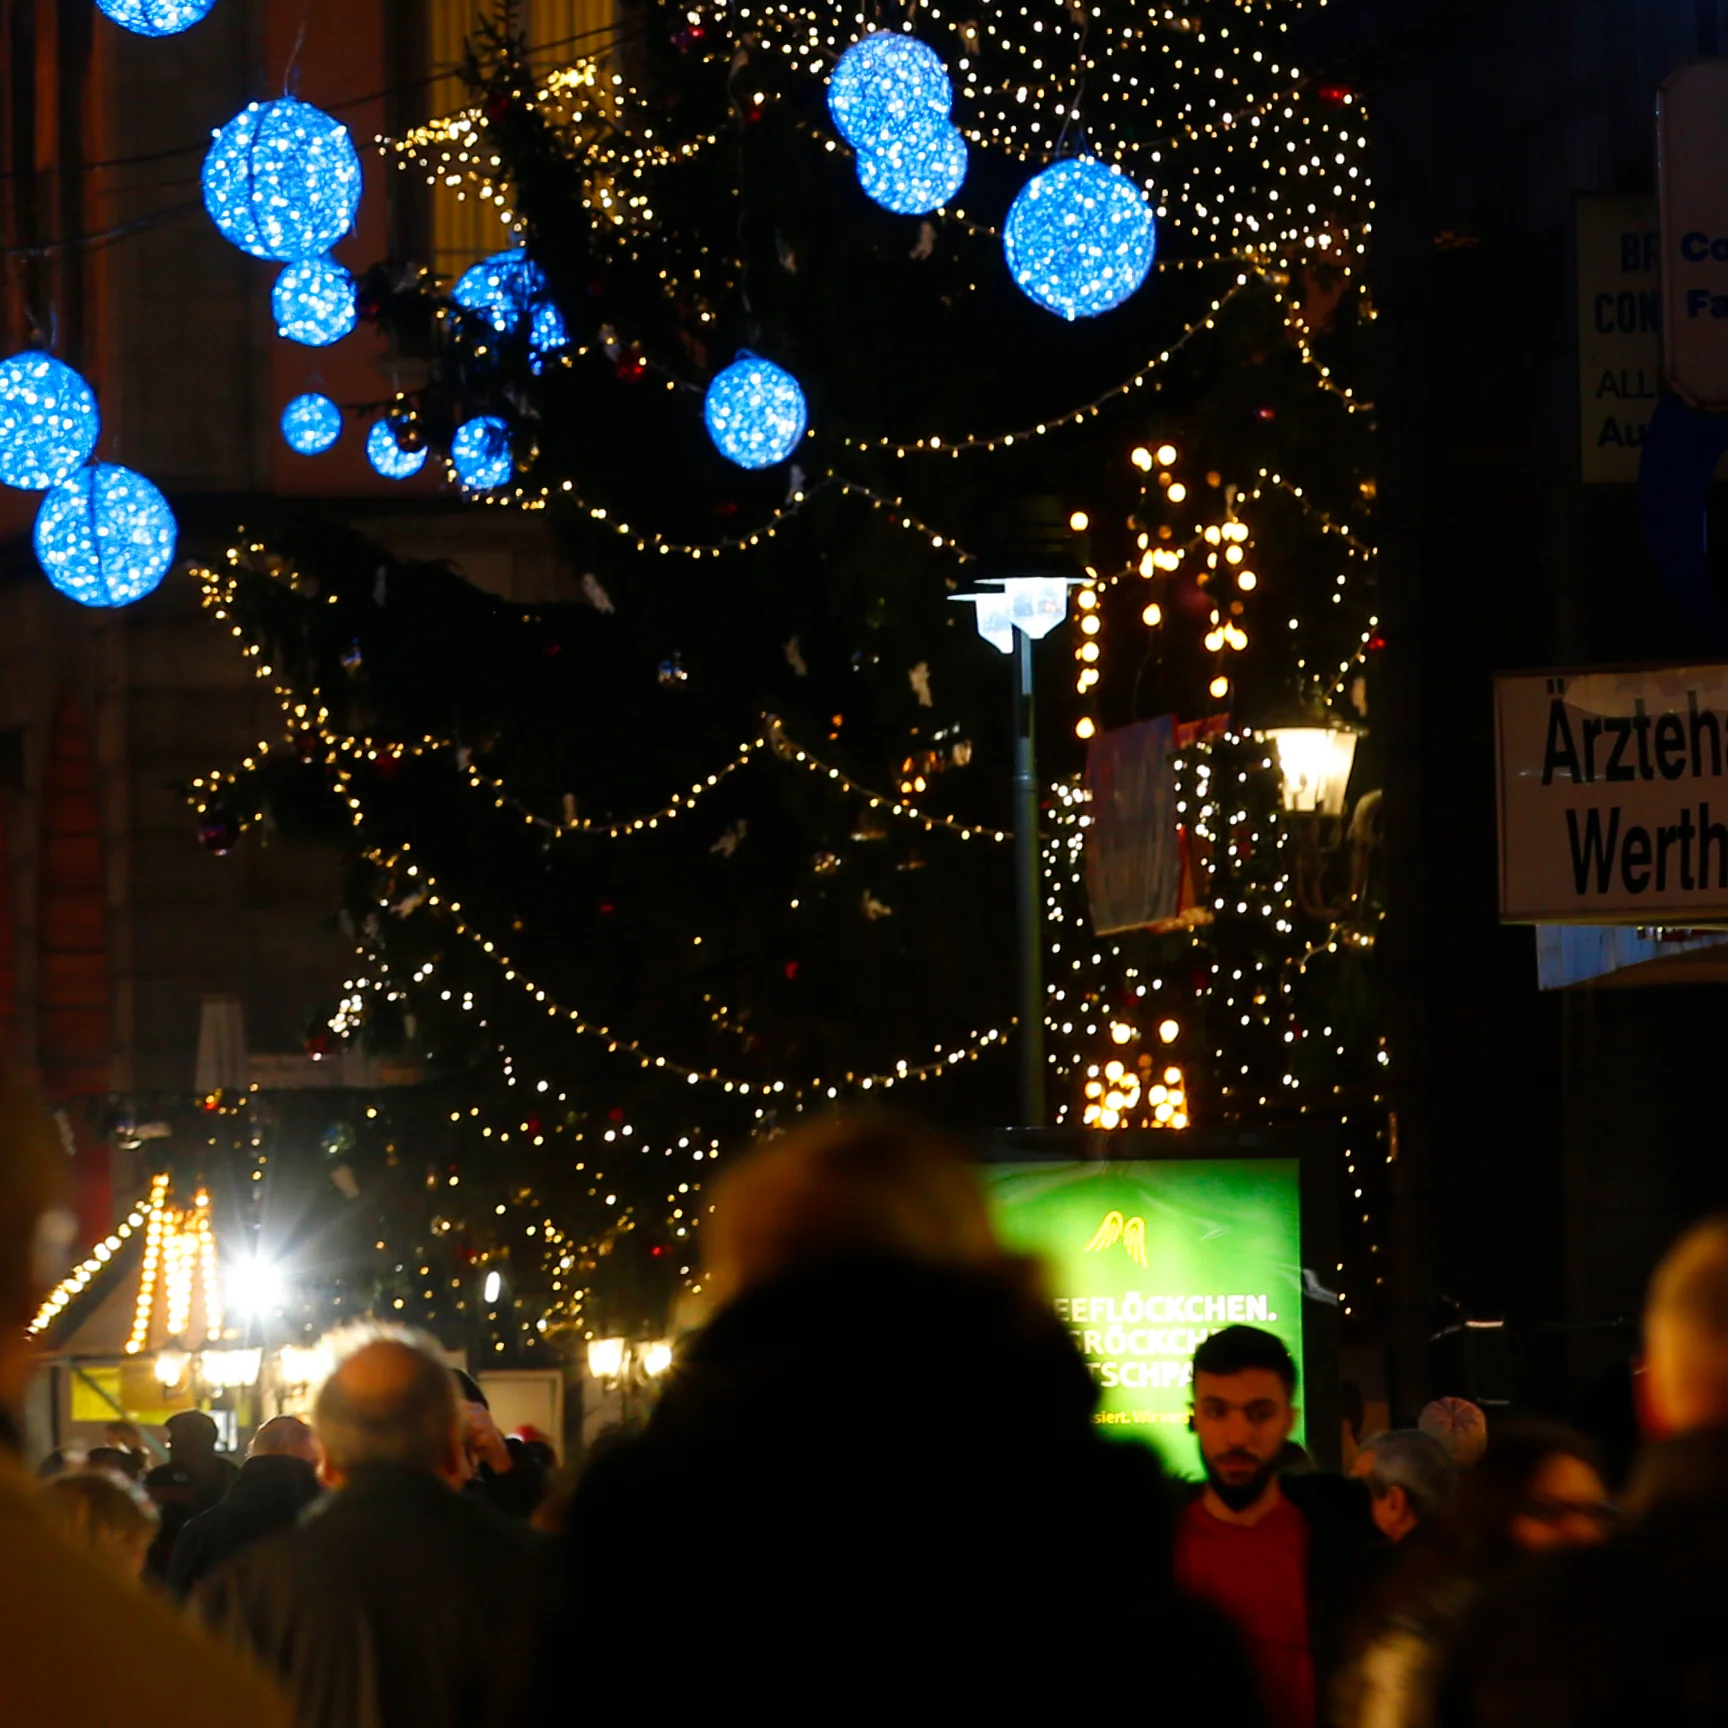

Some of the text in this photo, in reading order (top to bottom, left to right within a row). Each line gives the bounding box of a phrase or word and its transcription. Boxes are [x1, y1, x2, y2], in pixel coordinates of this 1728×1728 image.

[1541, 678, 1728, 786] Ärzteh
[1565, 802, 1728, 895] Werth
[1053, 1291, 1278, 1322] EEFLÖCKCHEN.
[1093, 1410, 1130, 1424] siert.
